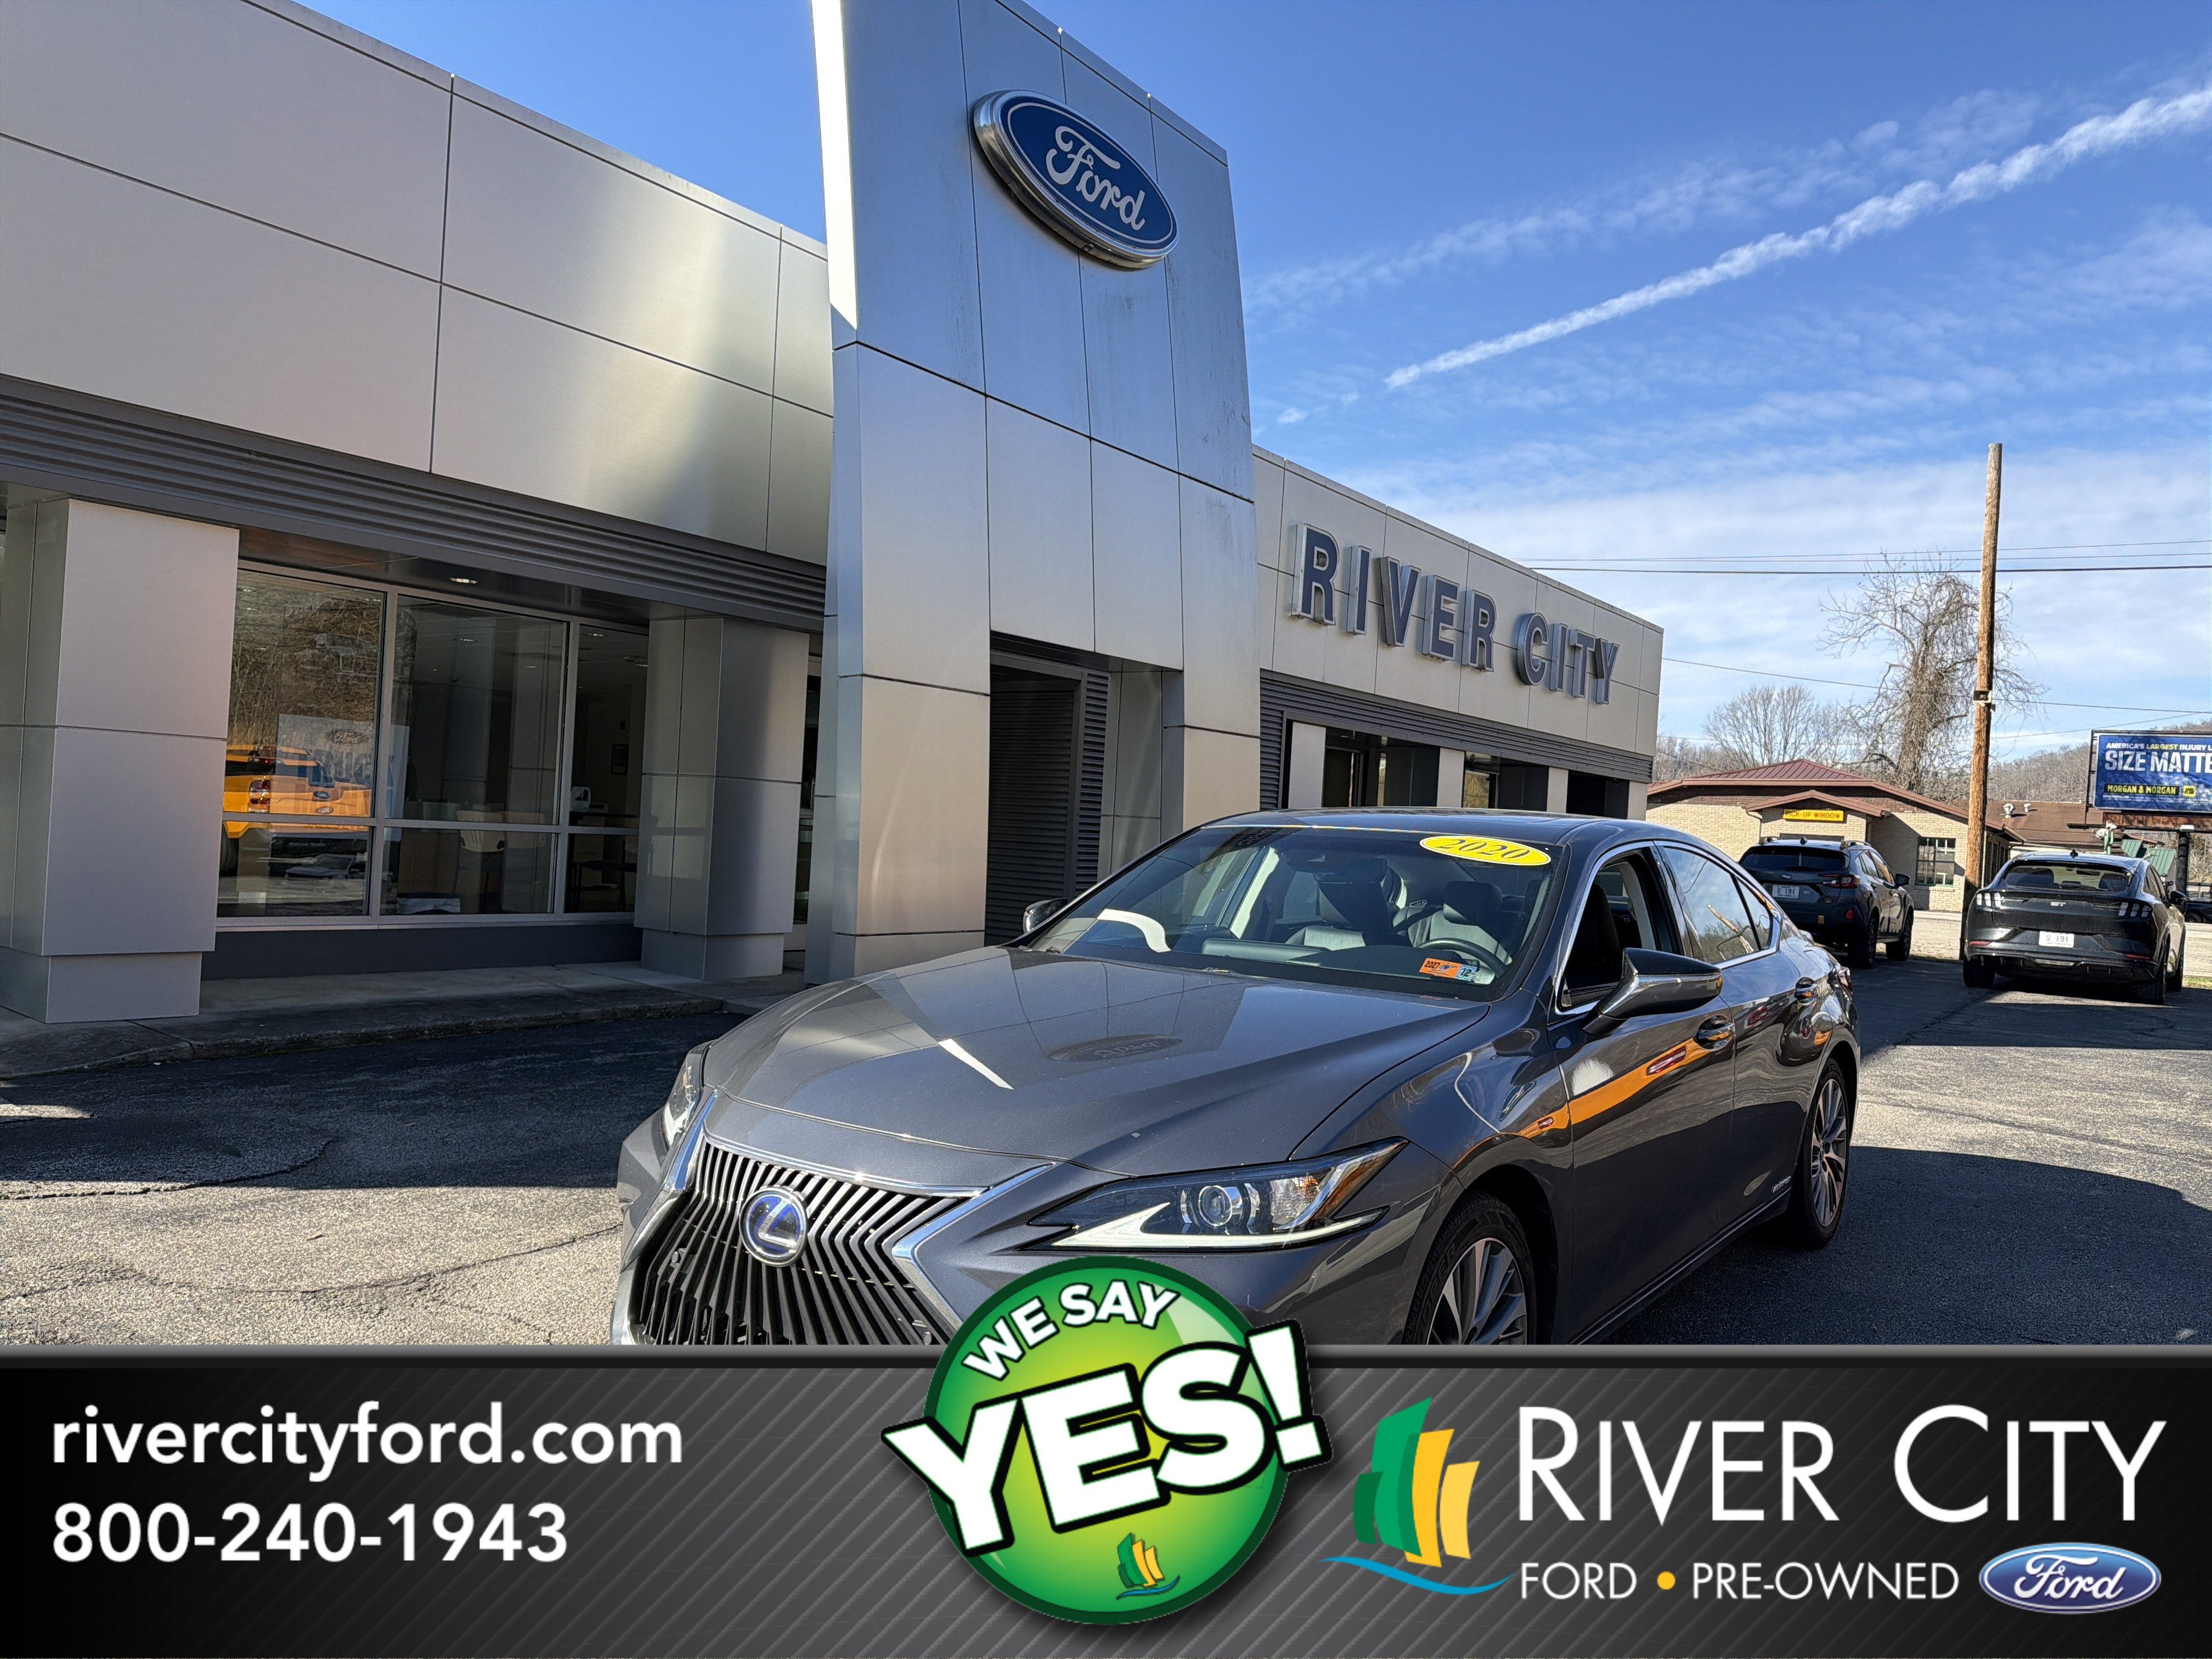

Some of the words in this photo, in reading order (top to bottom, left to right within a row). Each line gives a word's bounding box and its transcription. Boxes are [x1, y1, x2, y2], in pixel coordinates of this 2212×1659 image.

[1046, 126, 1146, 230] Ford
[1291, 523, 1497, 673] RIVER
[1517, 612, 1620, 705] CITY
[2104, 750, 2147, 771] SIZE
[2107, 785, 2137, 793] MORGAN
[2138, 785, 2144, 794] &
[2146, 786, 2176, 795] MORGAN
[1436, 839, 1530, 859] 2020
[1424, 961, 1441, 969] 2027
[1460, 968, 1472, 977] 12
